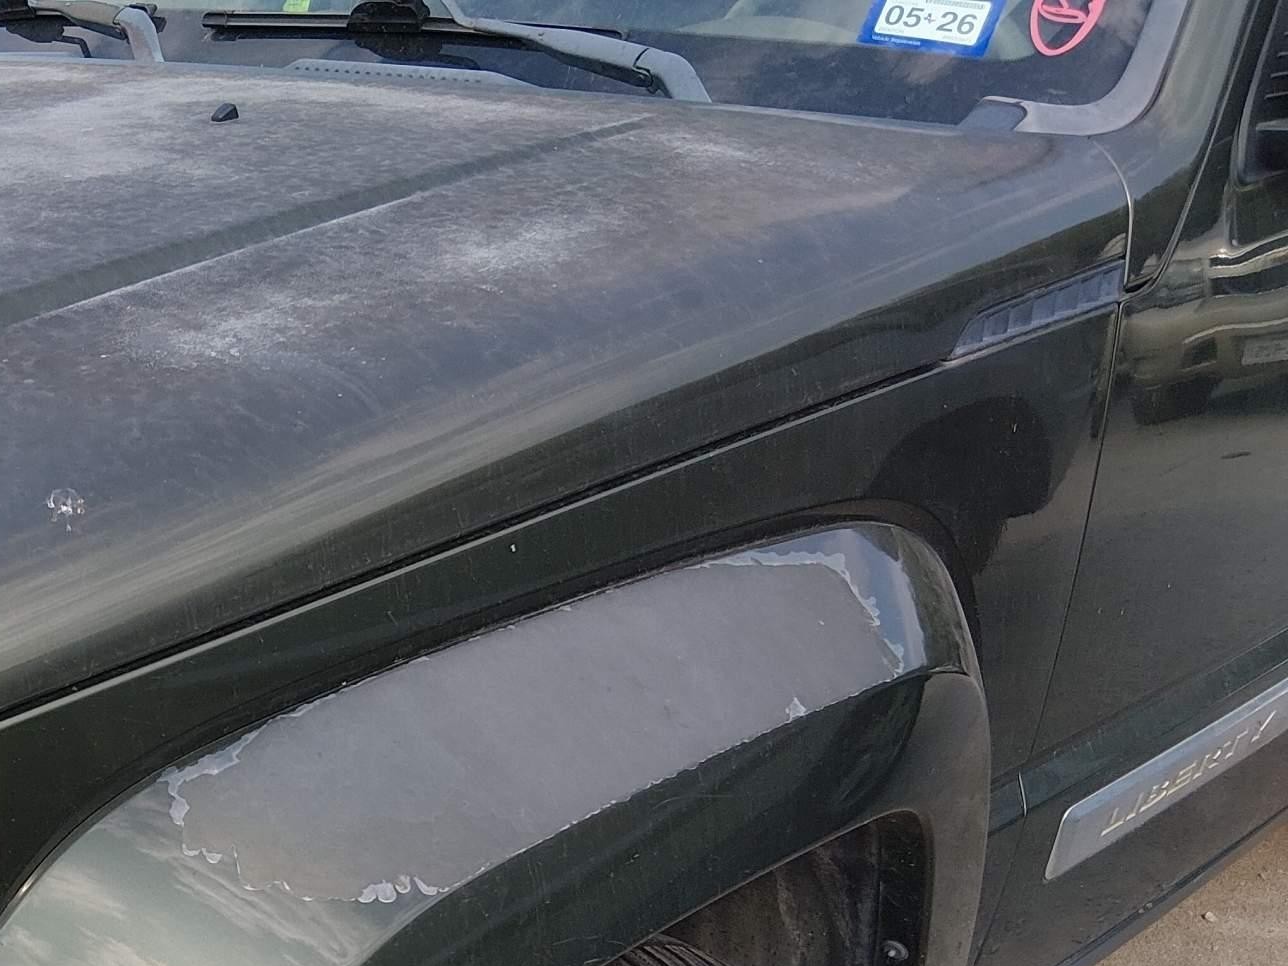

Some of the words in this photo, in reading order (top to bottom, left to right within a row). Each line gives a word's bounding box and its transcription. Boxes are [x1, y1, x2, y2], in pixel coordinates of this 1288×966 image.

[885, 5, 924, 27] 05
[936, 12, 977, 34] 26
[1100, 711, 1277, 837] LIBERTY
